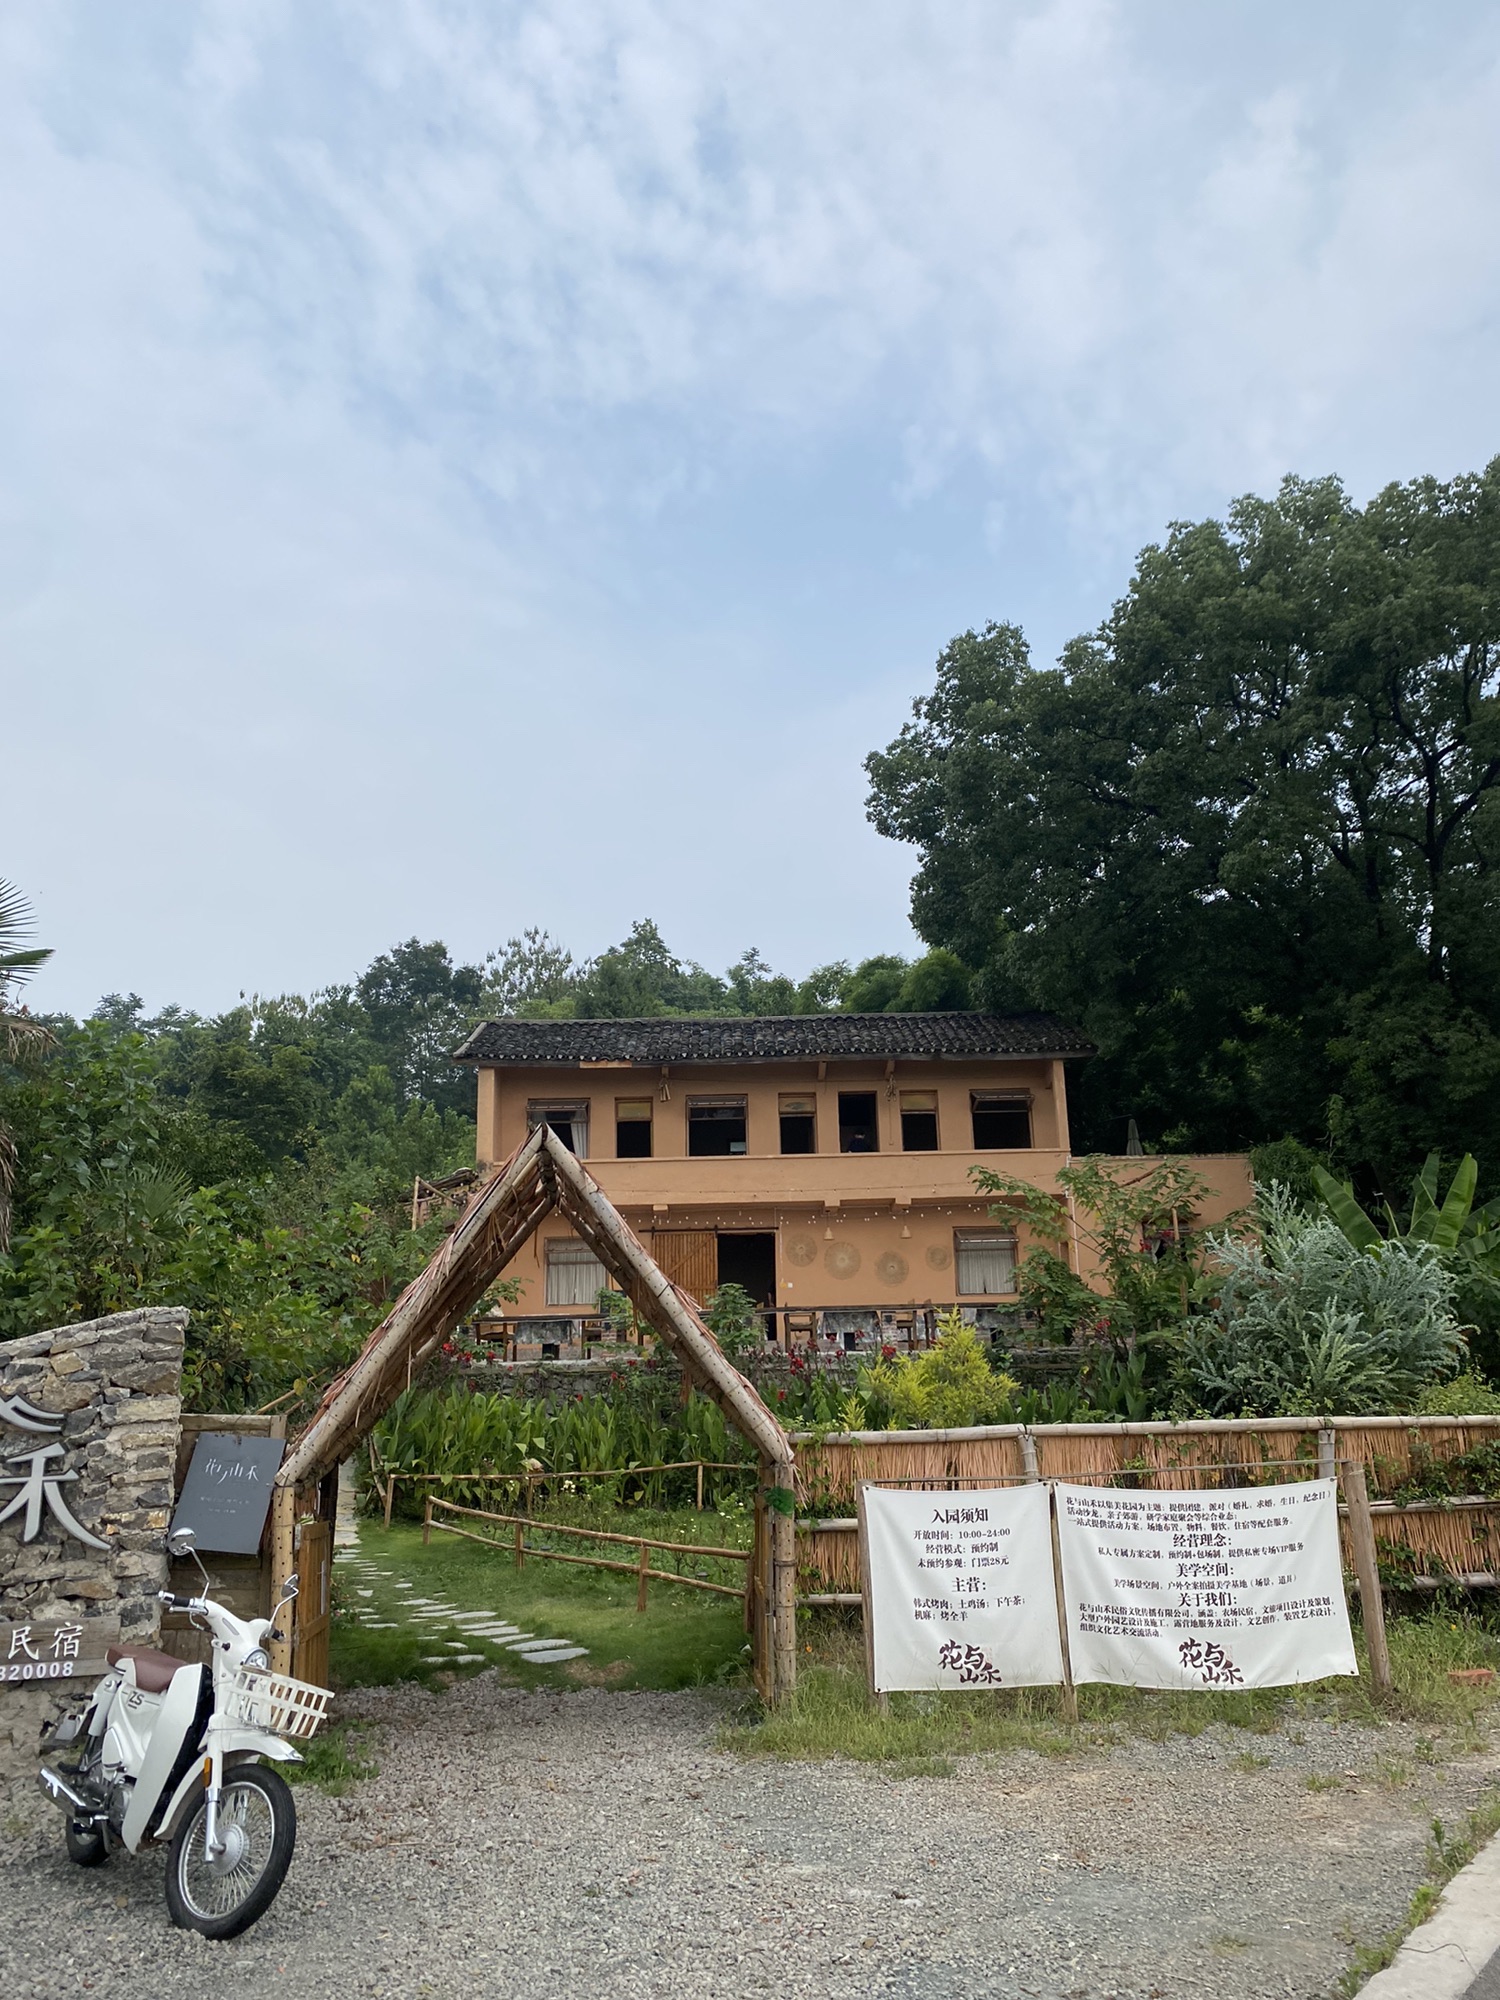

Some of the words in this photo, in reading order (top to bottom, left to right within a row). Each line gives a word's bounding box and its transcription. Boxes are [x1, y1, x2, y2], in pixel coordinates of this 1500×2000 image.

[931, 1508, 988, 1524] 入园须知
[1173, 1533, 1232, 1547] 经营理念：
[1176, 1563, 1234, 1577] 美学空间：
[951, 1577, 987, 1592] 主营：
[1178, 1592, 1237, 1607] 关于我们：
[8, 1622, 83, 1660] 民宿
